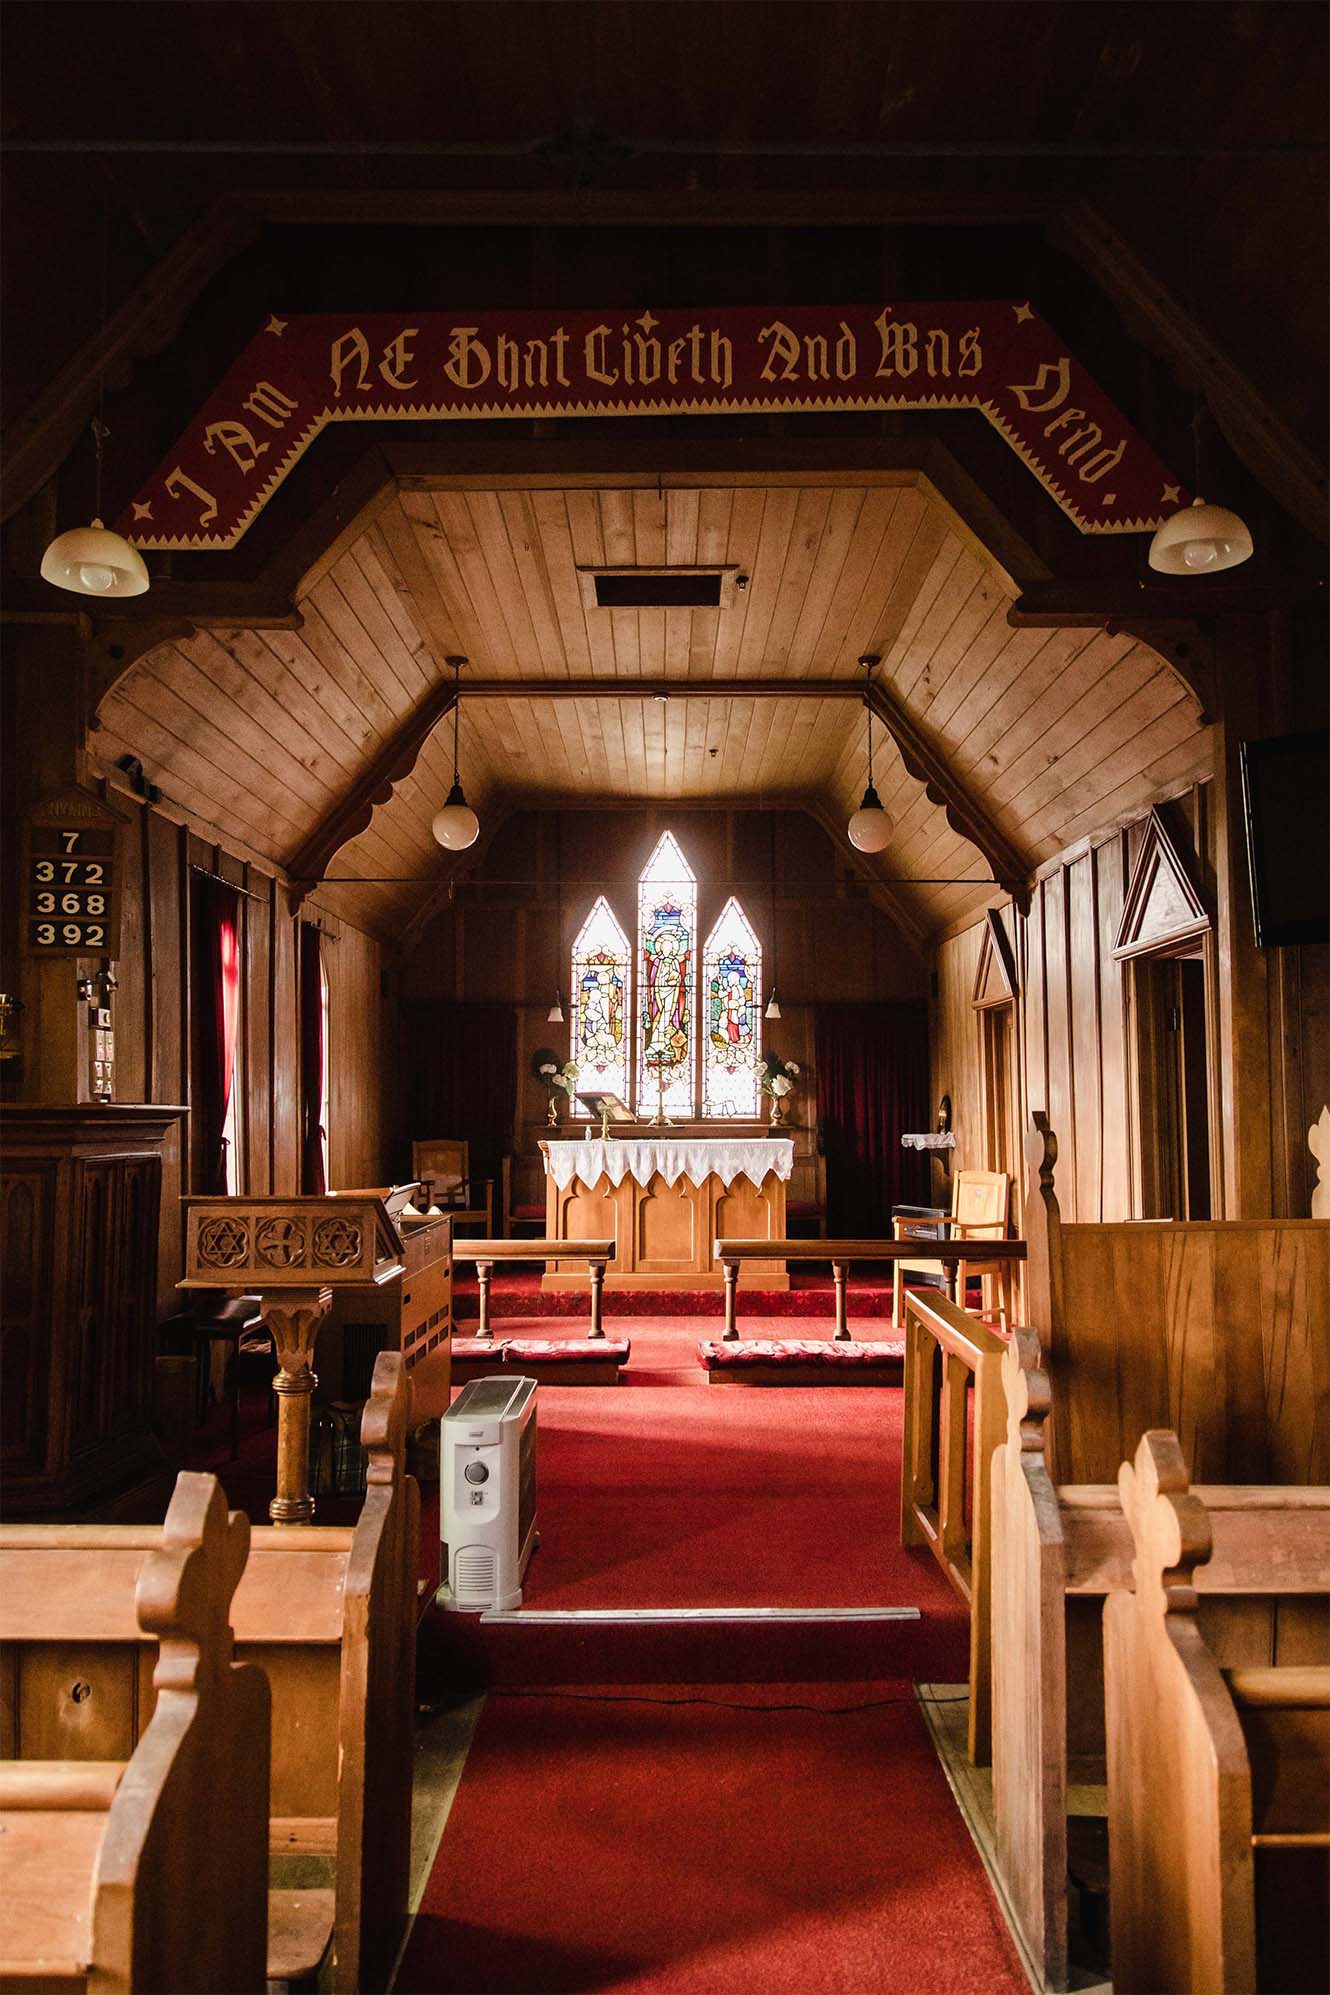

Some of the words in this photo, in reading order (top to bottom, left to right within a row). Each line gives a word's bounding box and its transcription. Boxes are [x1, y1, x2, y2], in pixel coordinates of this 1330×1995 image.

[203, 381, 299, 476] Am
[443, 326, 571, 393] That
[583, 322, 733, 390] Liveth
[757, 320, 857, 383] And
[874, 306, 983, 379] Was
[62, 832, 80, 853] 7
[35, 861, 104, 885] 372
[36, 892, 105, 915] 368
[37, 923, 104, 947] 392
